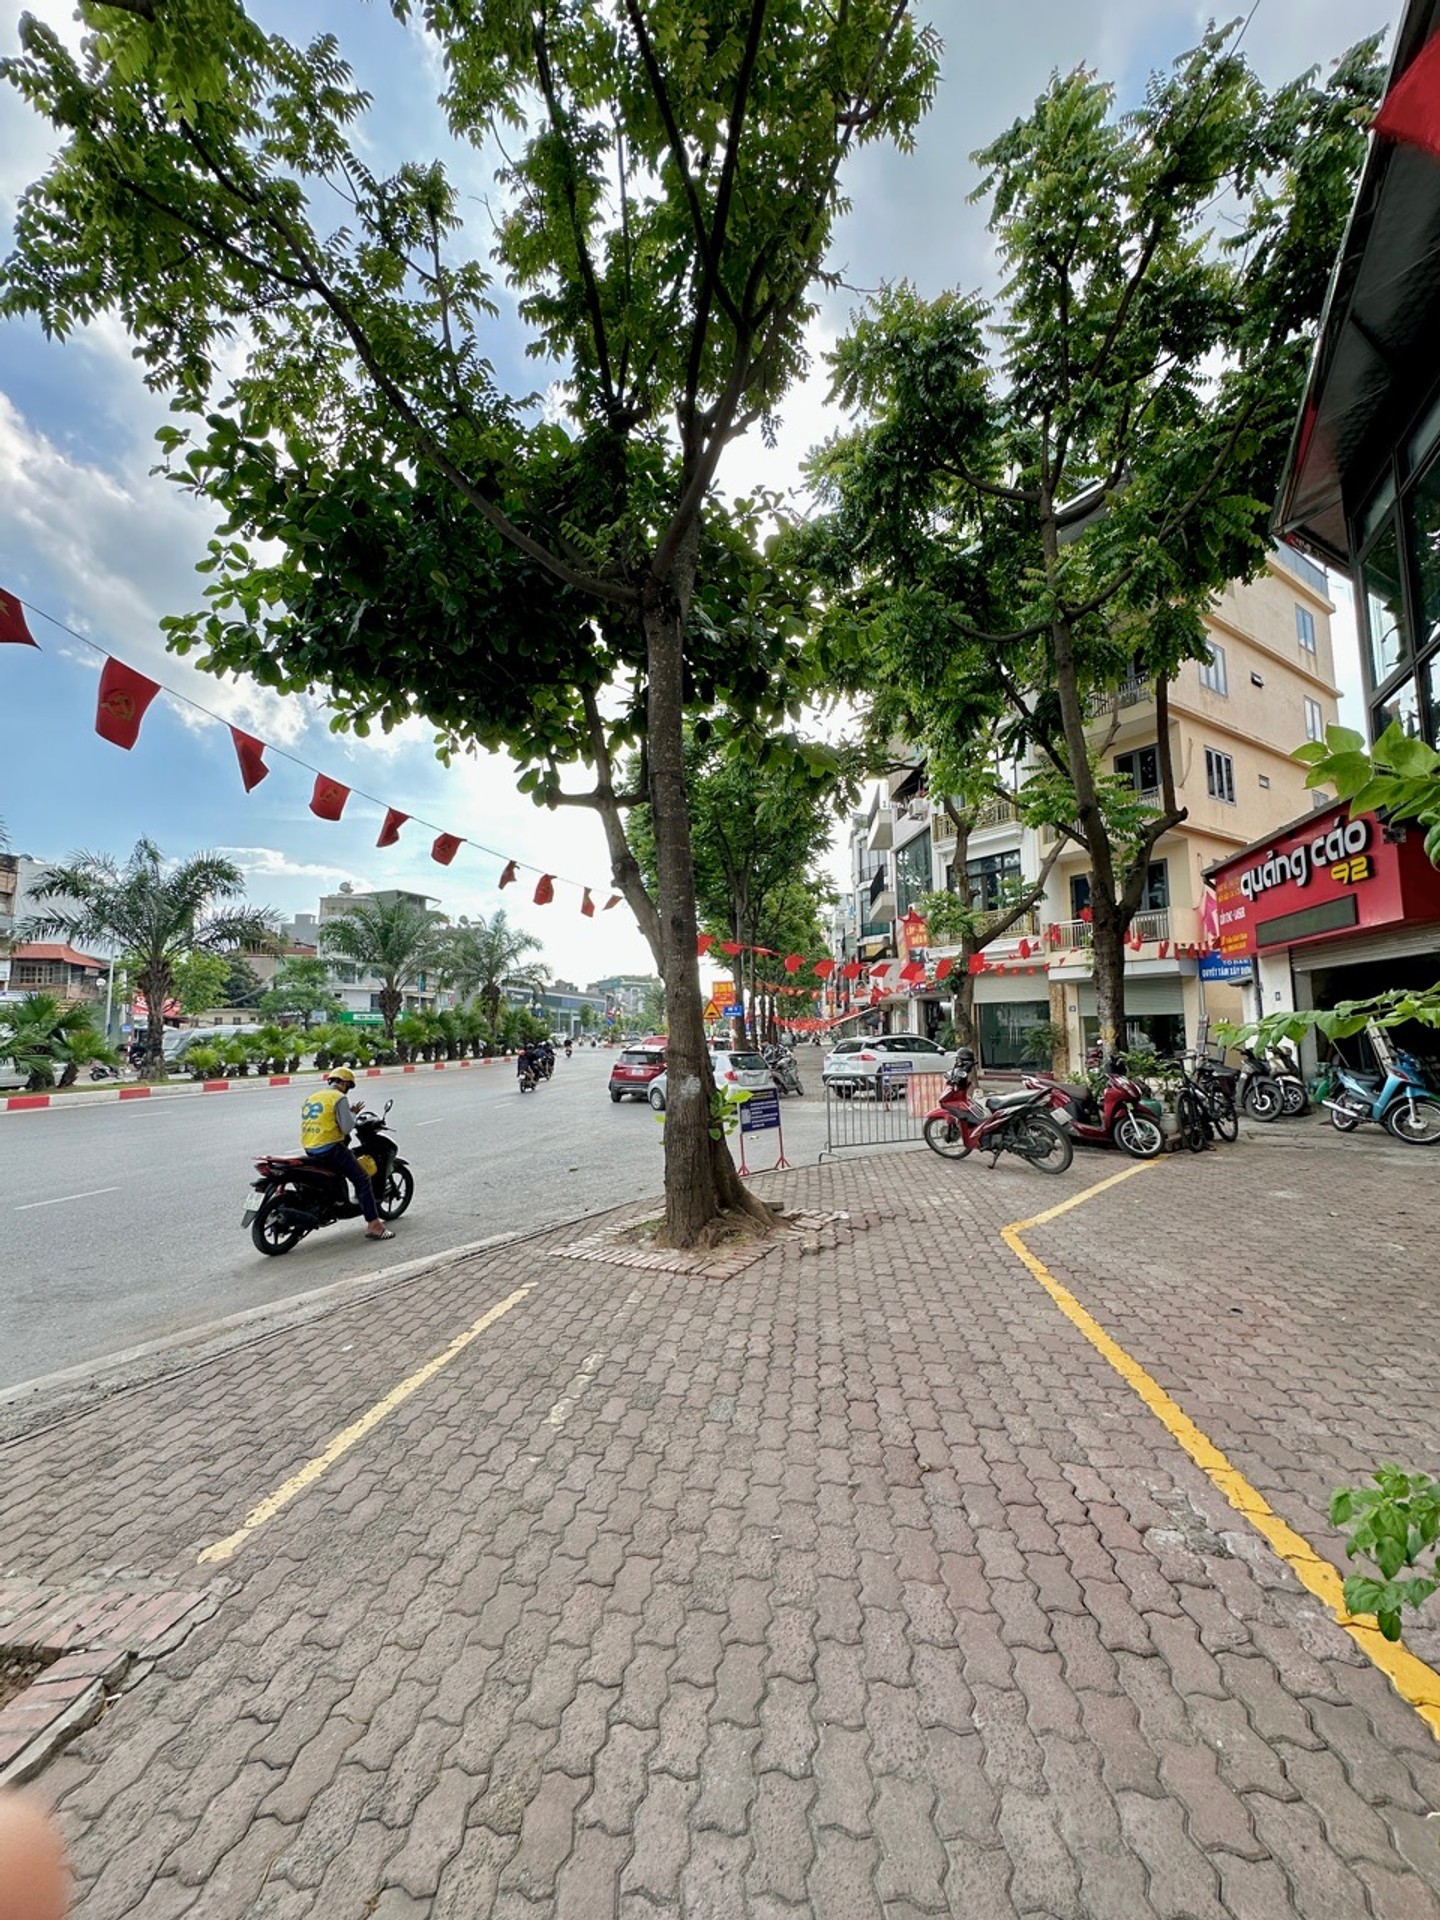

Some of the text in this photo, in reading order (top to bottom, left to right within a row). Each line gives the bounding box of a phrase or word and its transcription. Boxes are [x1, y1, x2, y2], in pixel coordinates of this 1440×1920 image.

[1241, 817, 1366, 901] quảng cáo
[1331, 856, 1369, 884] 92
